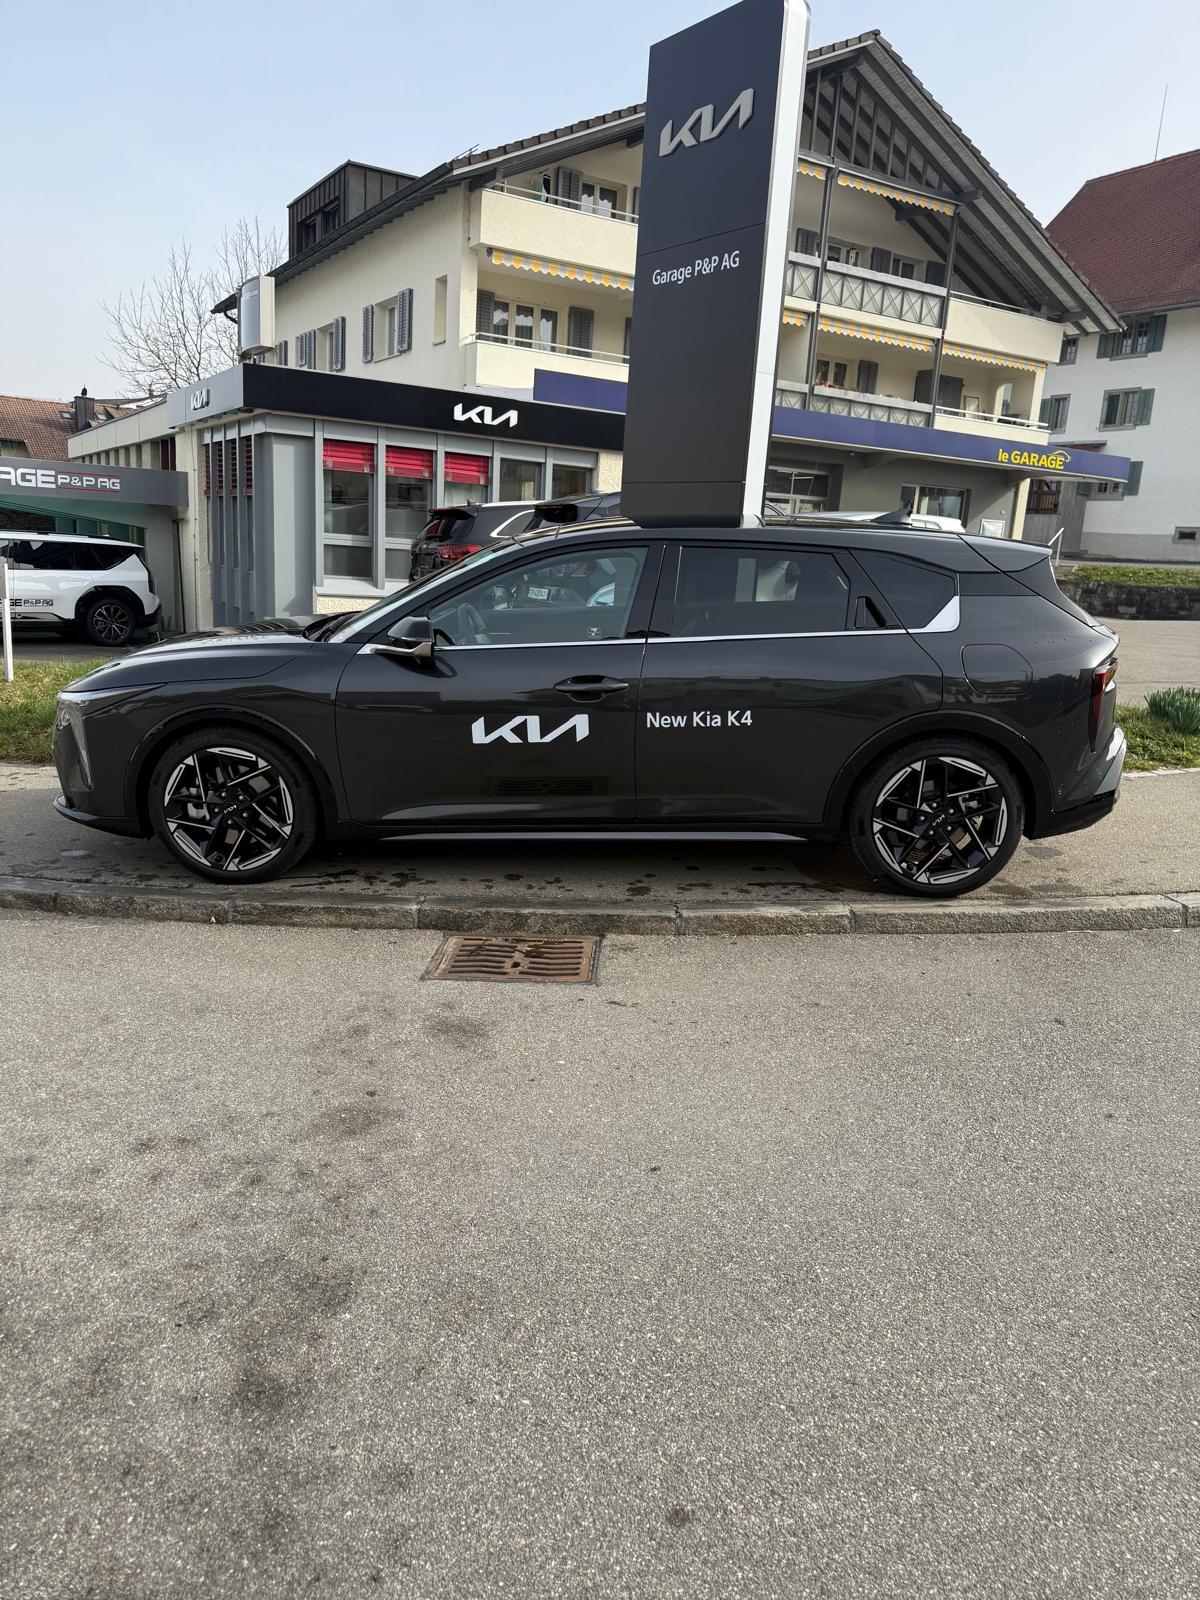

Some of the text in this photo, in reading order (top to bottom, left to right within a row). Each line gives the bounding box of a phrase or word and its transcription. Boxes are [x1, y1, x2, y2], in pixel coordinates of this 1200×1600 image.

[659, 88, 755, 158] KIA
[652, 250, 740, 285] Garage P&P AG
[453, 402, 518, 427] KIA
[998, 448, 1065, 470] le GARAGE
[57, 474, 96, 488] P&P
[97, 477, 121, 490] AG
[471, 713, 589, 744] KIA
[646, 710, 753, 728] New Kia K4
